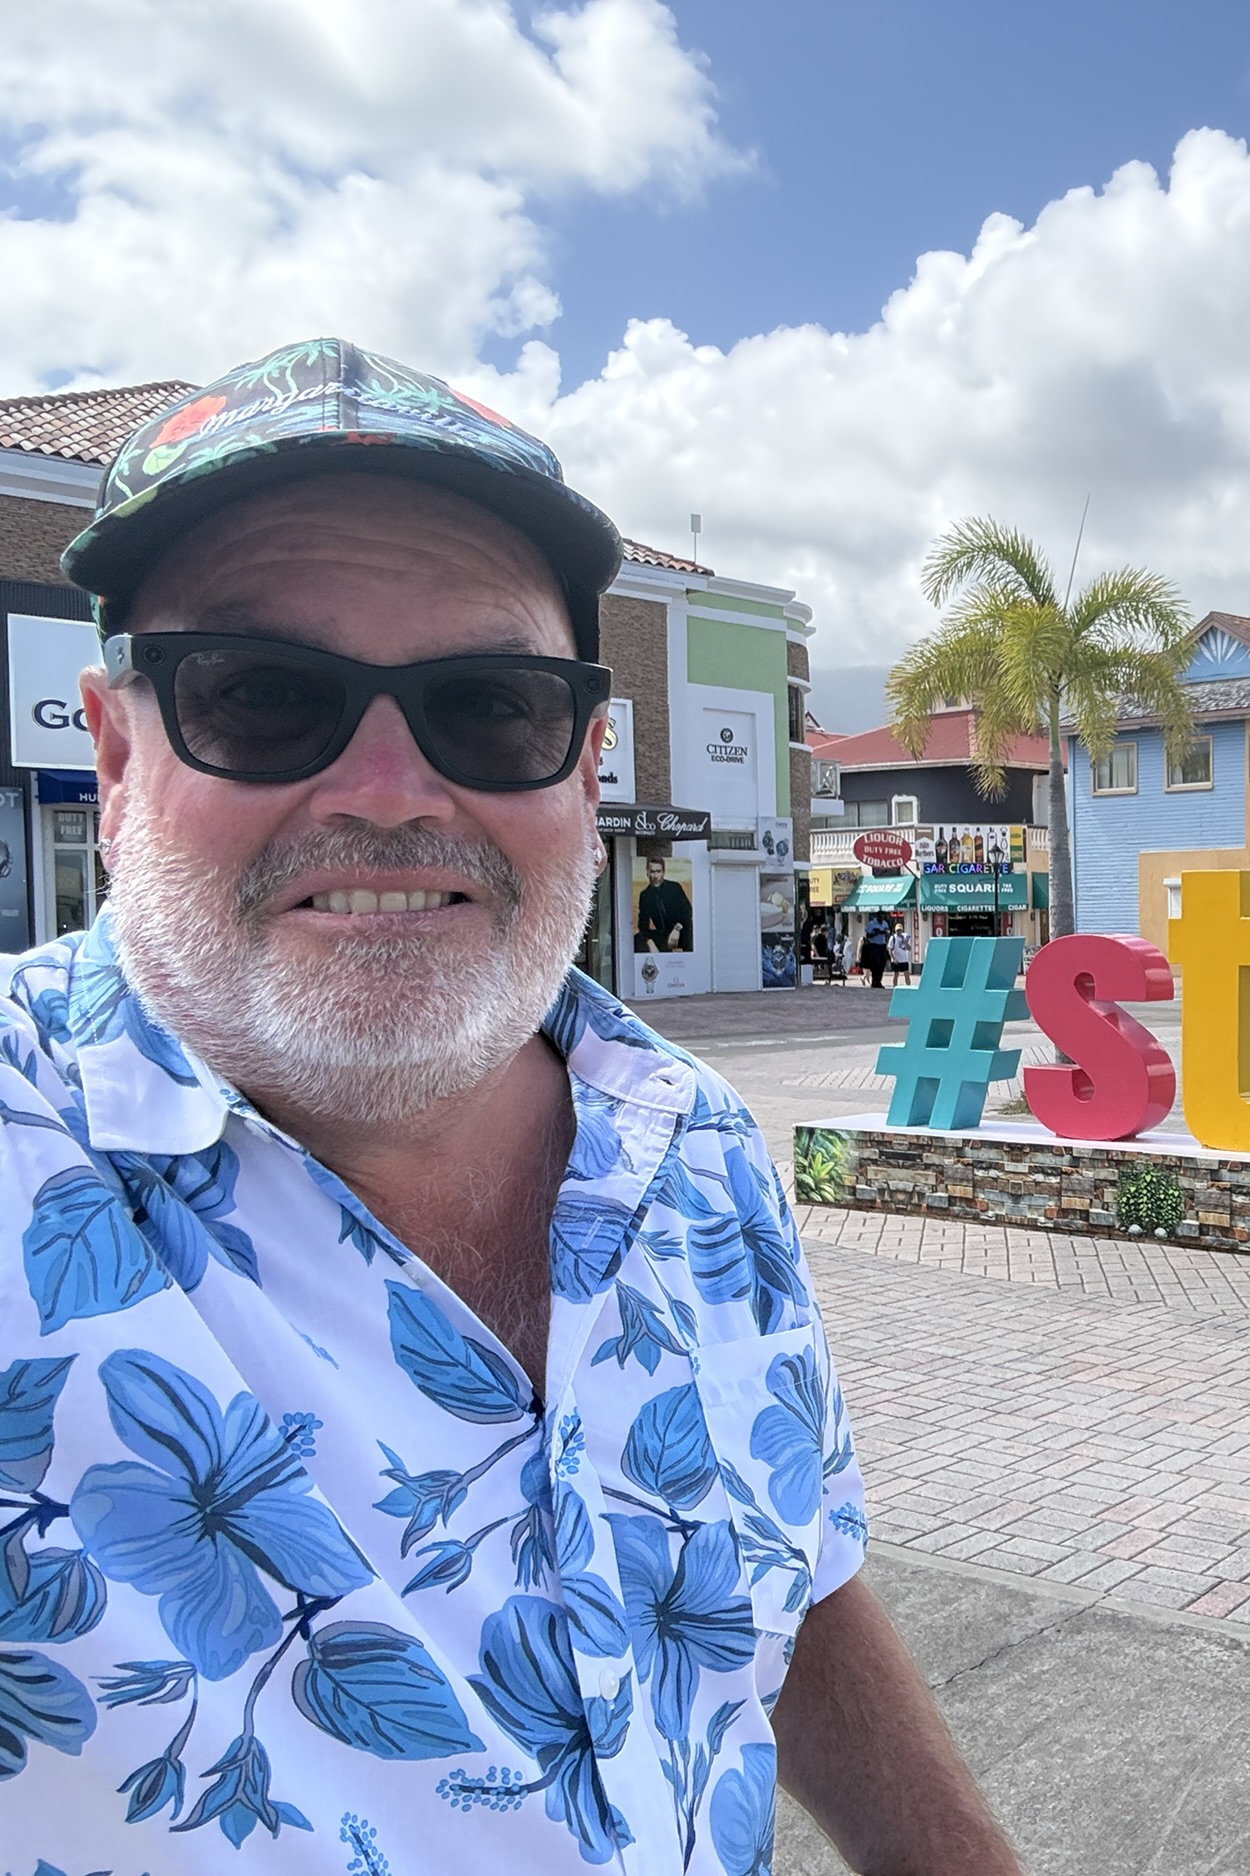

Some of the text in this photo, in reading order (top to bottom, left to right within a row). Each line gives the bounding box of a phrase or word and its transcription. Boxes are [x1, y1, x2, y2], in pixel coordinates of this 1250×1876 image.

[706, 743, 748, 757] CITIZEN
[711, 754, 745, 765] ECO-DRIVE
[58, 812, 84, 823] DUTY
[60, 824, 82, 836] FREE
[657, 812, 709, 837] Chopard
[863, 832, 904, 847] LIQUOR
[863, 846, 902, 856] DUTY FREE
[862, 854, 904, 868] TOBACCO
